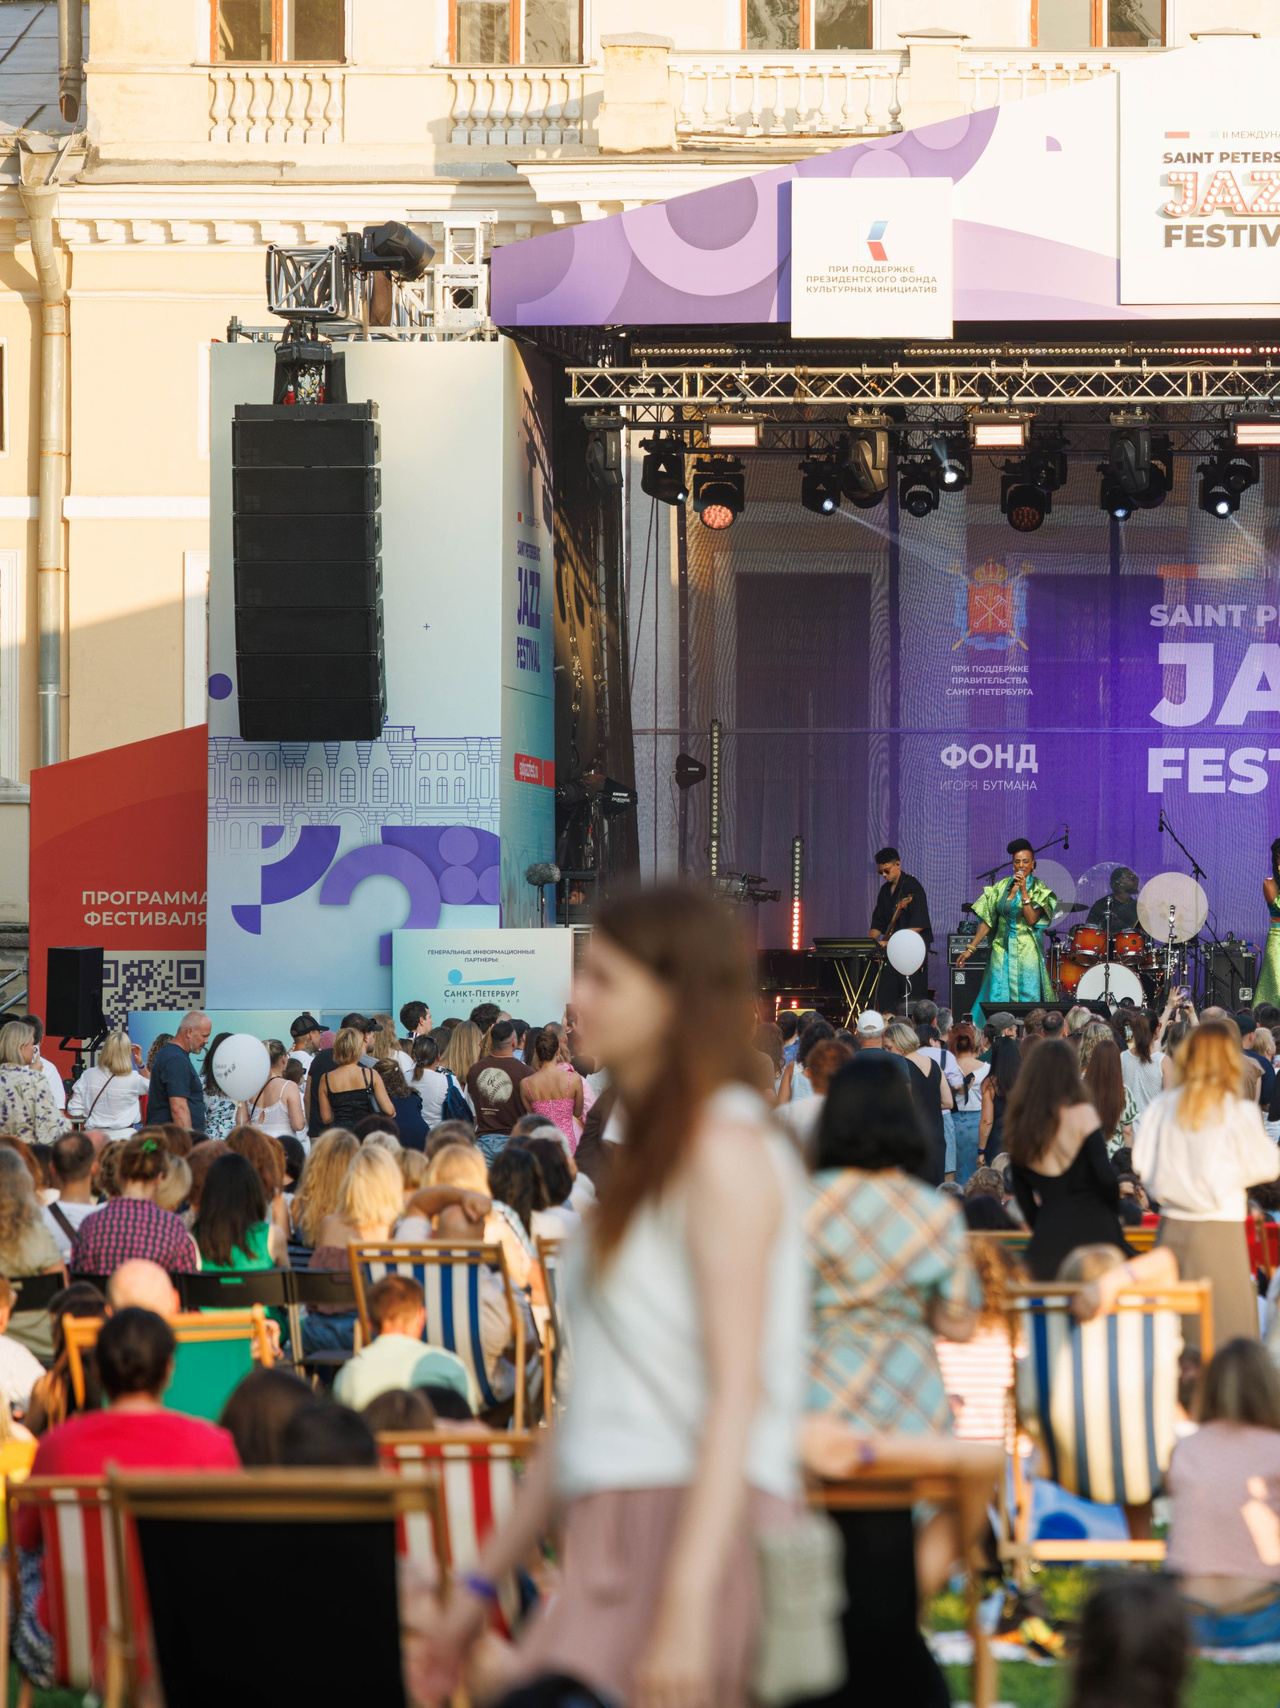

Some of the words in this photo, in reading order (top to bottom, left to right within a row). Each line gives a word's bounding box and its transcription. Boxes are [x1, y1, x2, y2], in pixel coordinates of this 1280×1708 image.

[1163, 152, 1214, 164] SAINT
[806, 276, 896, 284] ПРЕЗИДЕНТСКОГО
[876, 286, 937, 294] ИНИЦИАТИВ
[517, 567, 541, 630] JAZZ
[1149, 604, 1248, 627] SAINT
[517, 636, 541, 674] FESTIVAL
[940, 743, 1038, 774] ФОНД
[940, 780, 977, 791] ИГОРЯ
[983, 780, 1037, 790] БУТМАНА
[82, 891, 207, 905] ПРОГРАММА
[84, 911, 207, 926] ФЕСТИВАЛЯ
